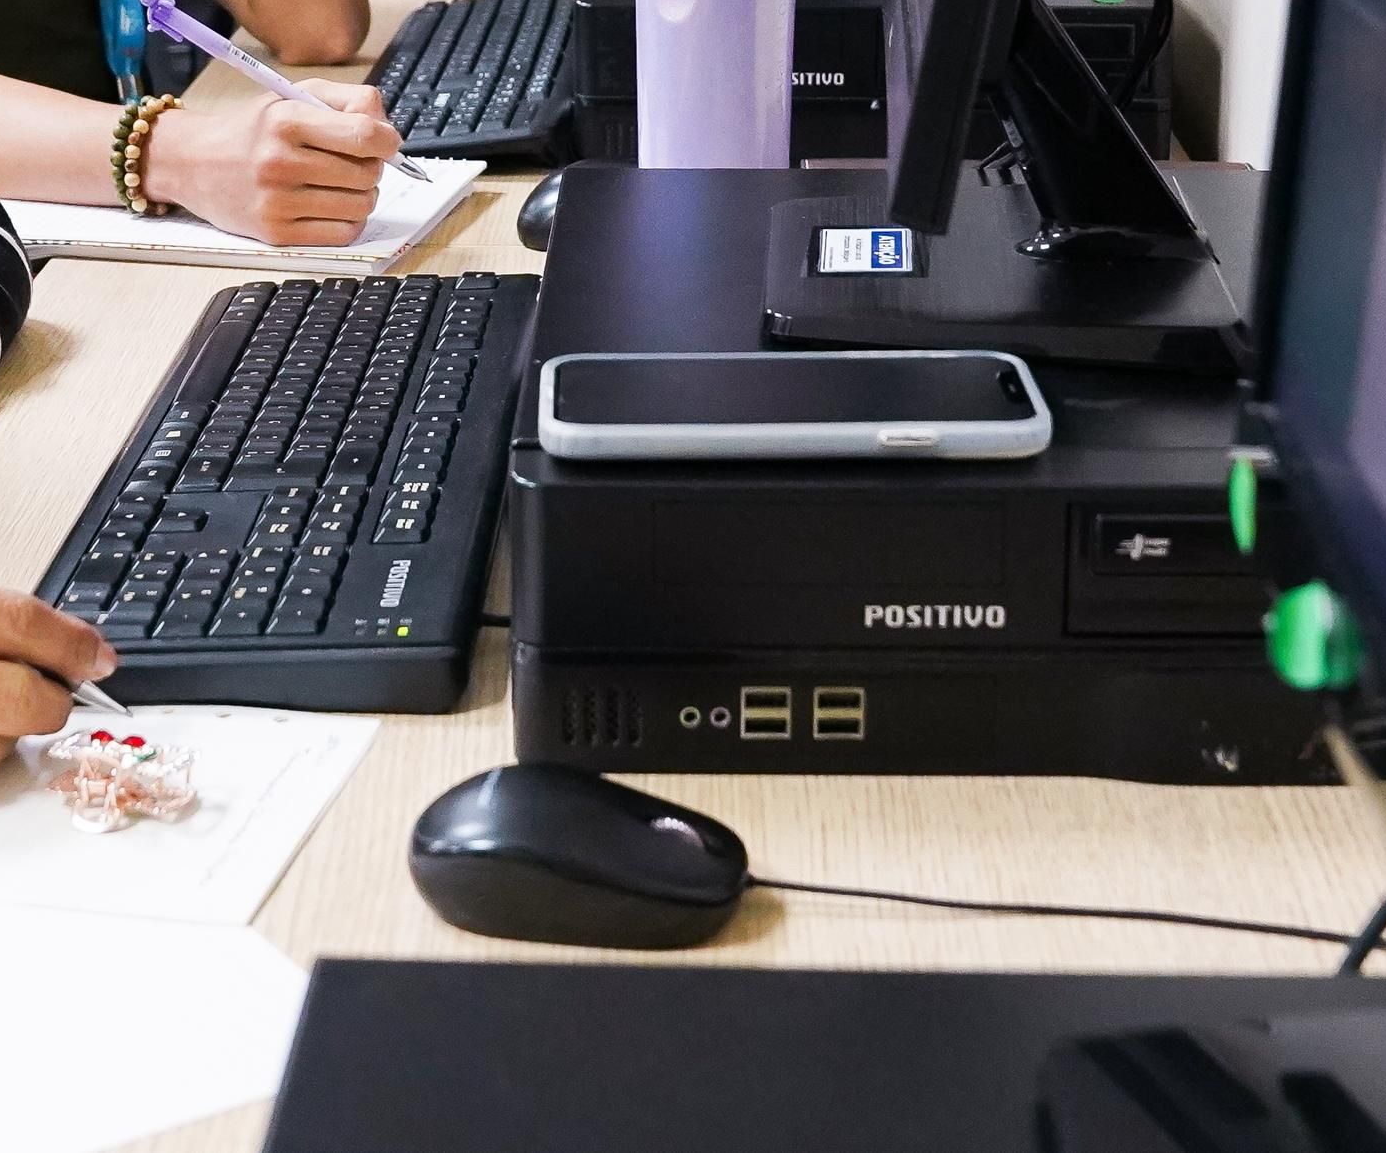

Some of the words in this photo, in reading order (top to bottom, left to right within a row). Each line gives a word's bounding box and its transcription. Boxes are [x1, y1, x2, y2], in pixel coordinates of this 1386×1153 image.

[792, 72, 845, 86] SITIVO
[874, 235, 900, 264] ATENÇÃO
[380, 559, 411, 608] POSITIVO
[864, 604, 1006, 628] POSITIVO
